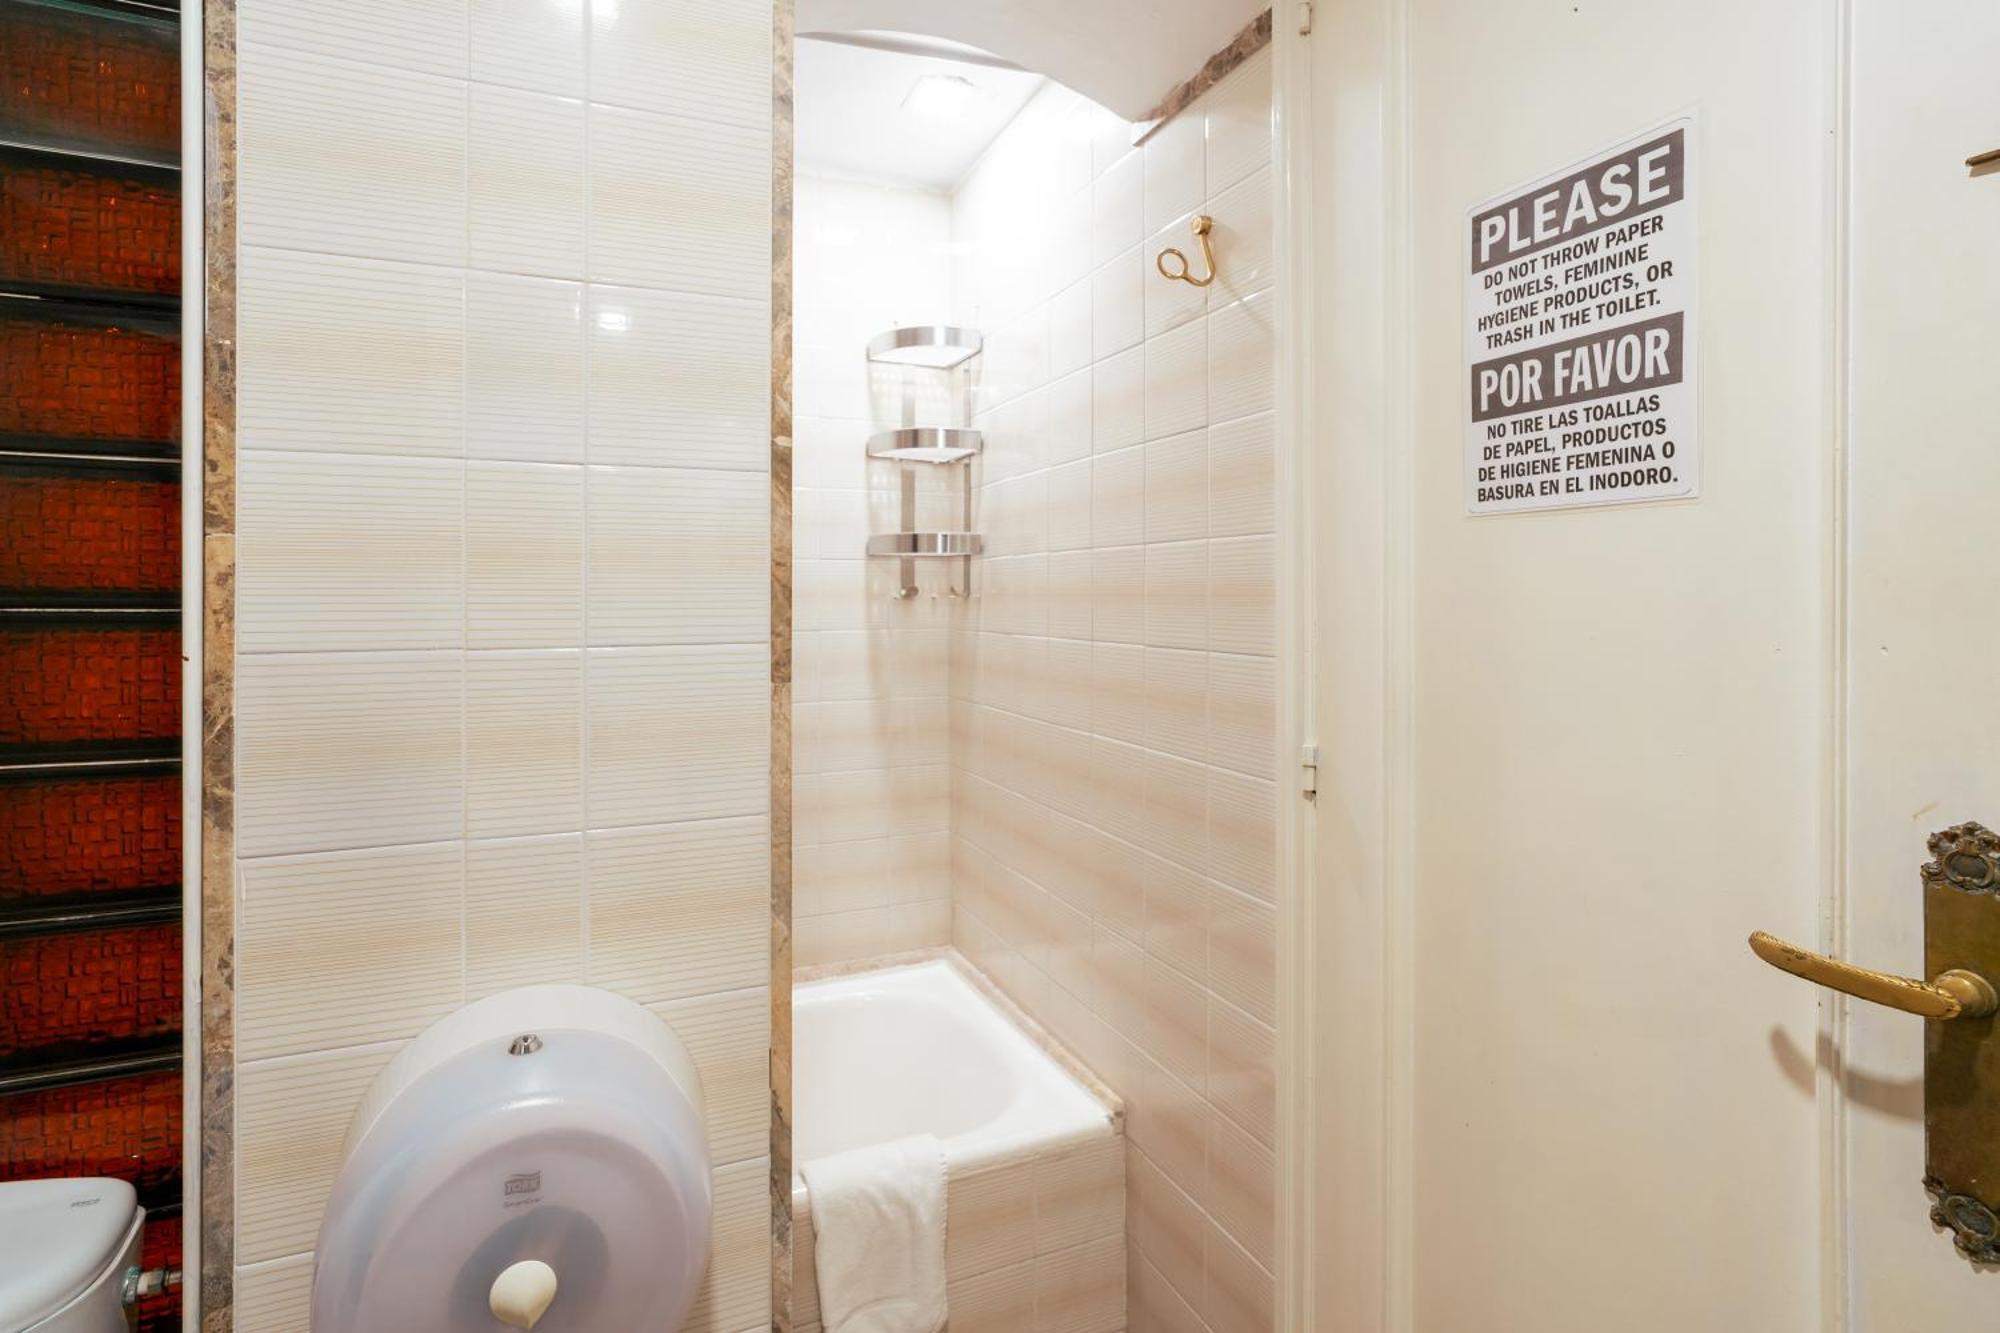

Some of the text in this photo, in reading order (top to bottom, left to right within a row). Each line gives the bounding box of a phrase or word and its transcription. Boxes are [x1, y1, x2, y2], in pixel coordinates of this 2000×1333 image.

[1480, 144, 1670, 264] PLEASE
[1484, 215, 1664, 290] DO NOT THROW PAPER
[1494, 244, 1648, 306] TOWELS, FEMININE
[1478, 261, 1673, 331] HYGIENE PRODUCTS, OR
[1486, 289, 1660, 349] TRASH IN THE TOILET.
[1480, 328, 1670, 412] POR FAVOR
[1484, 418, 1666, 460] DE PAPEL, PRODUCTOS
[1487, 395, 1660, 440] NO TIRE LAS TOALLAS
[1478, 441, 1675, 481] DE HIGIENE FEMENINA O
[1478, 467, 1678, 502] BASURA EN EL INODORO.
